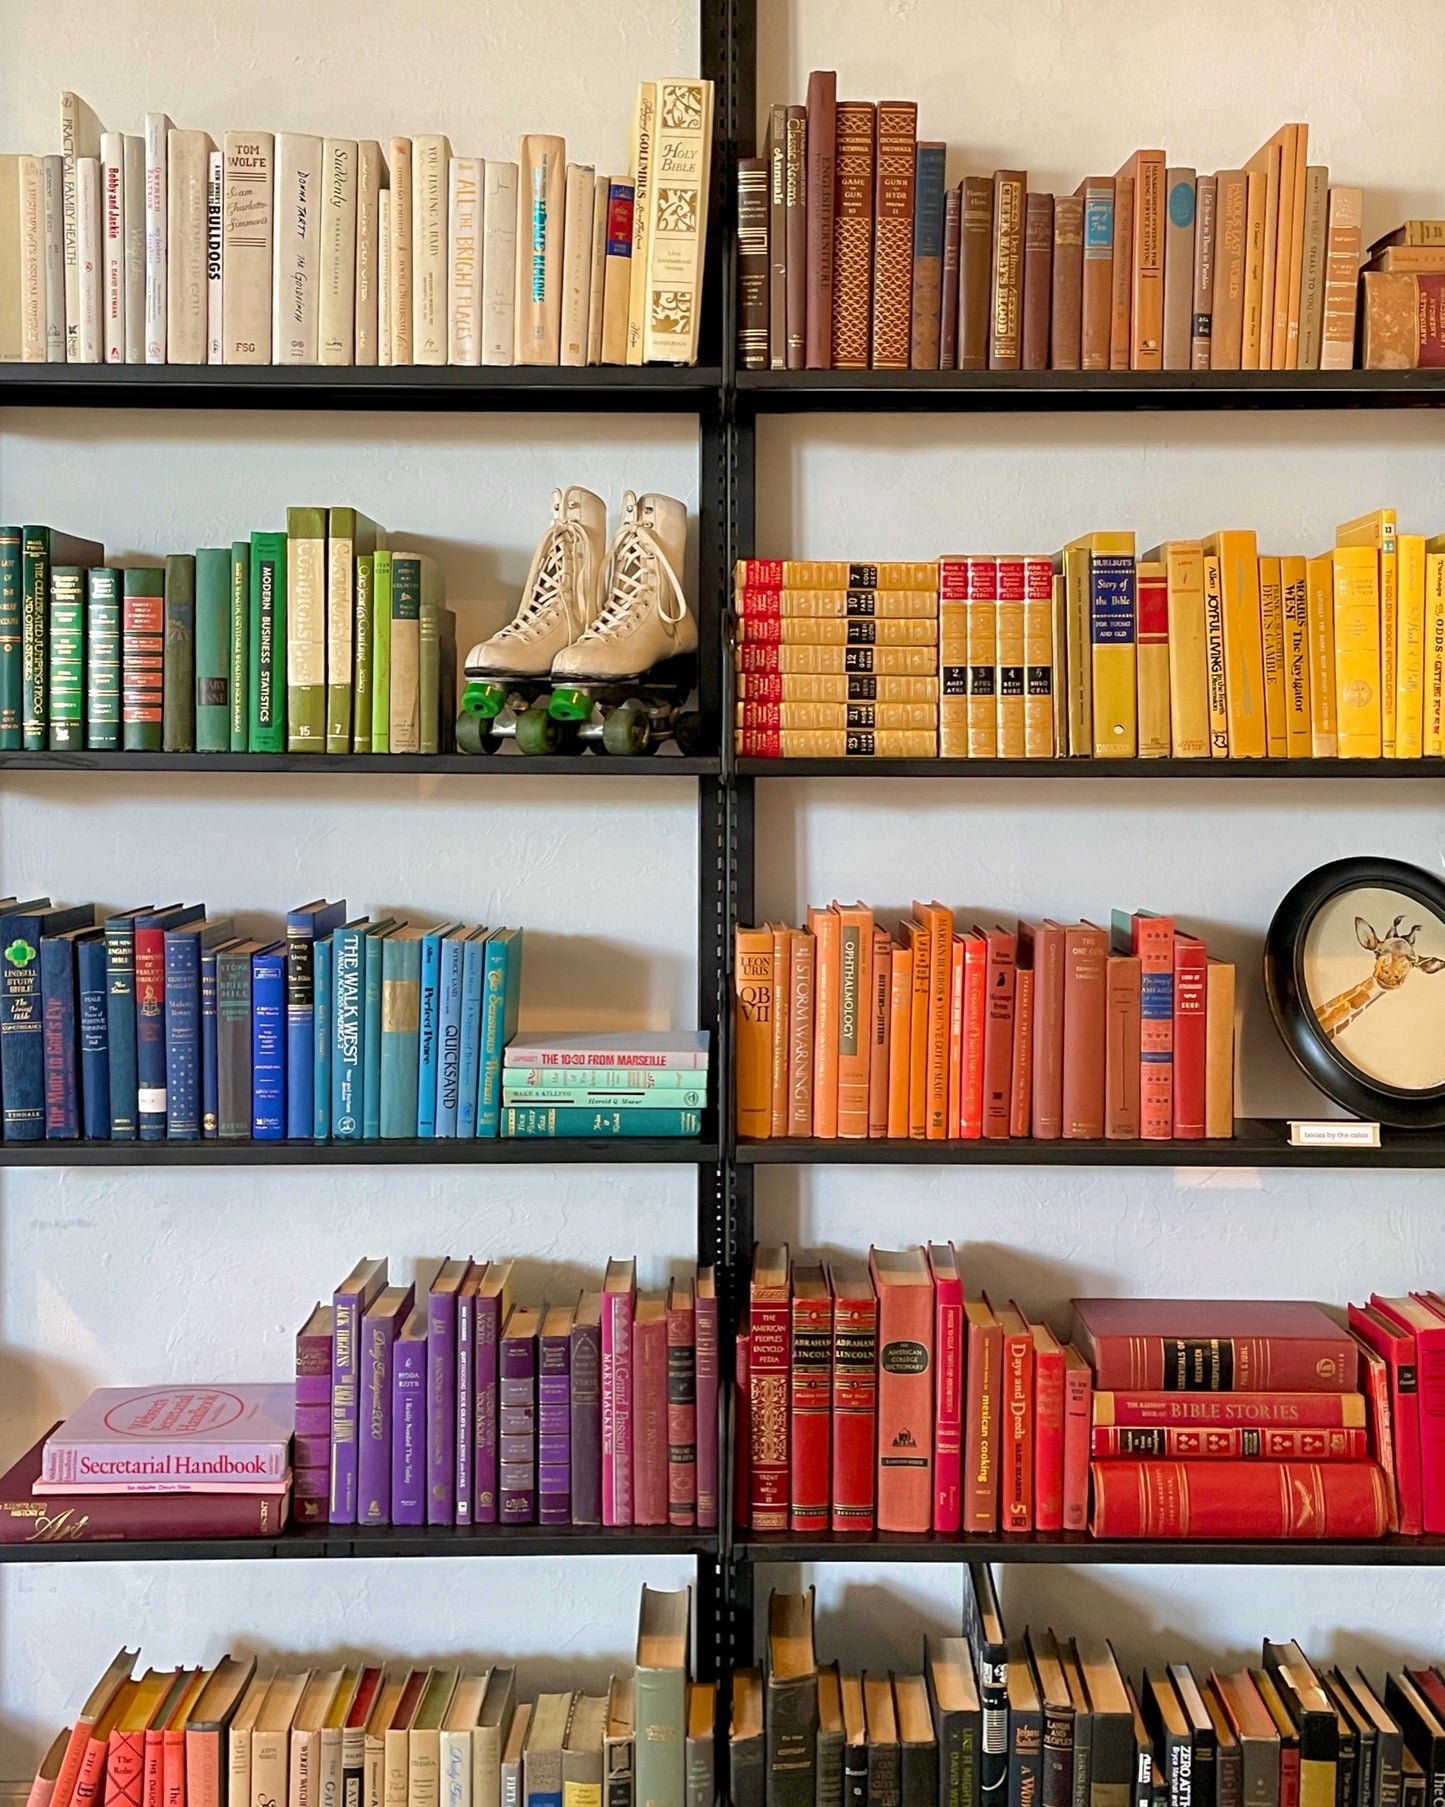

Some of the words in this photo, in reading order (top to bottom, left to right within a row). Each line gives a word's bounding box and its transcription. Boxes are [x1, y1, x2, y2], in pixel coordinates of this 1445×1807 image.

[63, 118, 74, 178] PRACTICAL
[235, 145, 260, 154] TOM
[664, 142, 697, 160] HOLY
[788, 118, 800, 161] Classic
[228, 157, 266, 167] WOLFE
[330, 148, 348, 208] Suddenly
[662, 158, 696, 173] BIBLE
[773, 149, 784, 205] Annuals
[108, 168, 118, 193] Bobby
[297, 170, 310, 202] DONNA
[456, 178, 476, 206] ALL
[787, 163, 800, 206] Rooms
[822, 157, 832, 213] ENGLISH
[842, 178, 865, 186] GAME
[65, 181, 76, 219] FAMILY
[110, 195, 118, 209] and
[1000, 184, 1012, 233] CREEK
[1232, 183, 1242, 226] FAMOUS
[109, 210, 118, 239] Jackie
[296, 205, 306, 239] TARTT
[460, 212, 472, 230] THE
[532, 199, 548, 251] HOME
[66, 222, 76, 266] HEALTH
[209, 206, 220, 280] BULLDOGS
[822, 214, 832, 290] FURNITURE
[1232, 230, 1242, 255] LAST
[455, 236, 474, 288] BRIGHT
[999, 236, 1011, 285] MARY'S
[532, 254, 546, 303] REMEDIES
[1229, 260, 1238, 298] WORDS
[456, 296, 473, 340] PLACES
[996, 289, 1010, 334] BLOOD
[235, 342, 255, 352] FSG
[262, 567, 272, 610] MODERN
[1098, 578, 1117, 591] Story
[1119, 578, 1128, 588] of
[1208, 566, 1217, 588] Allen
[1384, 569, 1393, 584] The
[849, 597, 857, 608] 10
[1096, 594, 1108, 606] the
[1111, 595, 1130, 606] Bible
[1208, 594, 1222, 634] JOYFUL
[1262, 584, 1274, 631] DEVIL'S
[1285, 584, 1296, 621] WEST
[1296, 579, 1306, 627] MORRIS
[1384, 585, 1394, 618] GOLDEN
[262, 616, 271, 664] BUSINESS
[1096, 620, 1106, 628] FOR
[1108, 620, 1131, 628] YOUNG
[1384, 620, 1392, 648] BOOK
[1210, 636, 1222, 672] LIVING
[1294, 630, 1303, 652] The
[848, 654, 856, 664] 12
[952, 669, 958, 678] 2
[1008, 669, 1016, 678] 4
[1265, 634, 1276, 685] GAMBLE
[260, 671, 270, 722] STATISTICS
[1292, 654, 1304, 713] Navigator
[1384, 650, 1392, 716] ENCYCLOPEDIA
[298, 726, 310, 735] 15
[336, 724, 342, 734] 7
[344, 934, 358, 968] THE
[937, 918, 948, 956] MARIAN
[112, 956, 129, 964] BIBLE
[741, 958, 770, 966] LEON
[743, 966, 769, 976] URIS
[936, 957, 946, 994] BURROS
[6, 978, 34, 986] STUDY
[344, 972, 358, 1018] WALK
[740, 986, 771, 1005] QB
[796, 964, 810, 1020] STORM
[843, 942, 856, 1039] OPHTHALMOLOGY
[12, 1005, 32, 1014] Living
[424, 987, 434, 1028] Perfect
[742, 1006, 769, 1022] VII
[935, 1004, 945, 1038] YOU'VE
[344, 1020, 357, 1066] WEST
[423, 1031, 433, 1065] Peace
[935, 1040, 944, 1058] GOT
[444, 1025, 458, 1110] QUICKSAND
[541, 1054, 558, 1065] THE
[588, 1054, 615, 1066] FROM
[617, 1055, 667, 1066] MARSEILLE
[794, 1026, 809, 1100] WARNING
[935, 1060, 944, 1069] IT
[934, 1072, 944, 1099] MADE
[1327, 1132, 1336, 1140] by
[336, 1304, 350, 1326] JACK
[762, 1314, 776, 1322] THE
[336, 1330, 350, 1367] HIGGINS
[793, 1350, 832, 1358] LINCOLN
[794, 1338, 832, 1347] ABRAHAM
[836, 1338, 875, 1347] ABRAHAM
[836, 1350, 875, 1359] LINCOLN
[398, 1372, 420, 1380] HODA
[604, 1353, 612, 1387] MARY
[616, 1354, 627, 1366] A
[1012, 1344, 1026, 1376] Days
[616, 1368, 628, 1405] Grand
[1014, 1378, 1024, 1400] and
[604, 1390, 612, 1439] MACKEY
[981, 1395, 990, 1436] mexican
[1012, 1402, 1026, 1440] Deeds
[1170, 1402, 1220, 1418] BIBLE
[1225, 1404, 1299, 1420] STORIES
[614, 1410, 628, 1454] Passion
[80, 1456, 172, 1475] Secretarial
[176, 1455, 266, 1475] Handbook
[978, 1440, 990, 1482] cooking
[25, 1508, 89, 1541] Art
[1010, 1504, 1026, 1514] 5
[1046, 1720, 1070, 1730] LANDS
[116, 1756, 132, 1764] The
[950, 1752, 960, 1786] DAVID
[170, 1788, 179, 1805] The
[507, 1776, 516, 1803] FIFTY
[1434, 1771, 1444, 1796] The
